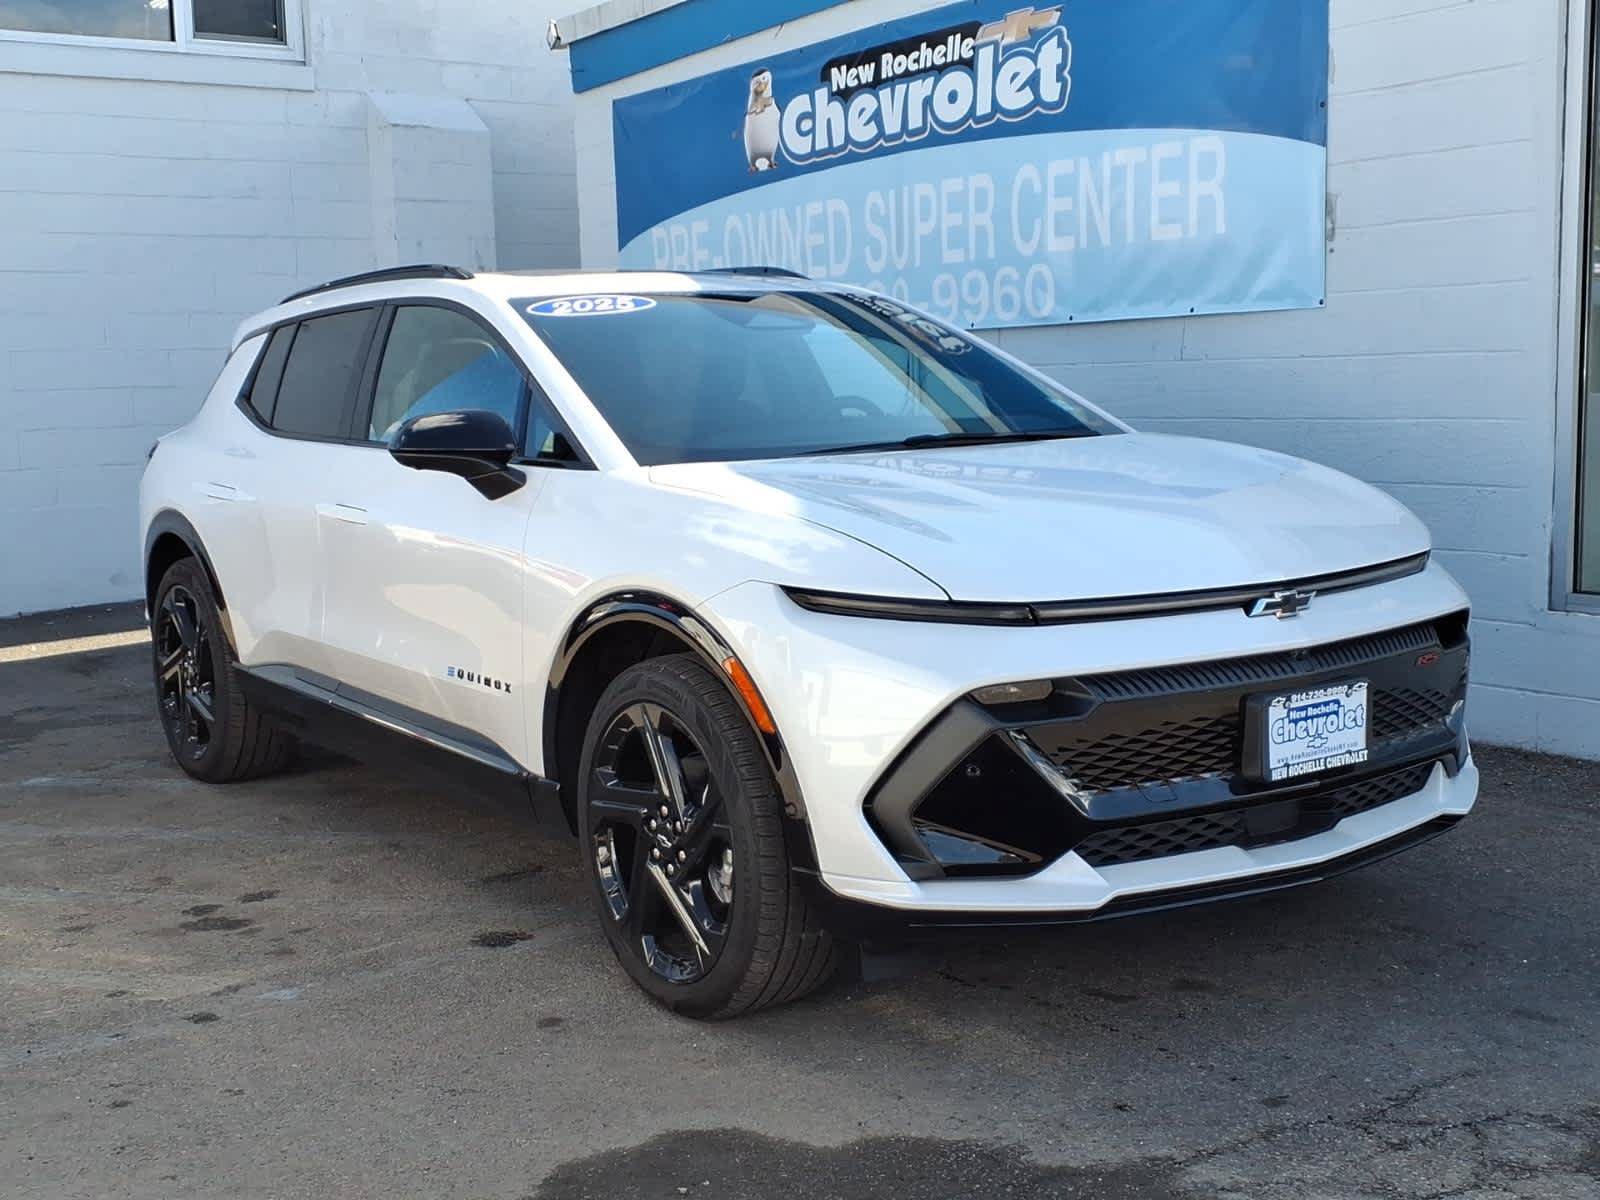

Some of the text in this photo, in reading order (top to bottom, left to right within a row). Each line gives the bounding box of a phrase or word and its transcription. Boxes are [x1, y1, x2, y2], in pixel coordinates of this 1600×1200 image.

[831, 33, 975, 92] New Rochelle
[780, 32, 1066, 158] Chevrolet
[651, 135, 1226, 277] PRE-OWNED SUPER CENTER
[551, 295, 636, 314] 2025
[447, 665, 512, 694] EQUINOX
[1271, 704, 1366, 744] Chevrolet
[1289, 702, 1339, 720] New Rochelle
[1271, 749, 1369, 781] NEW ROCHELLE CHEVROLET
